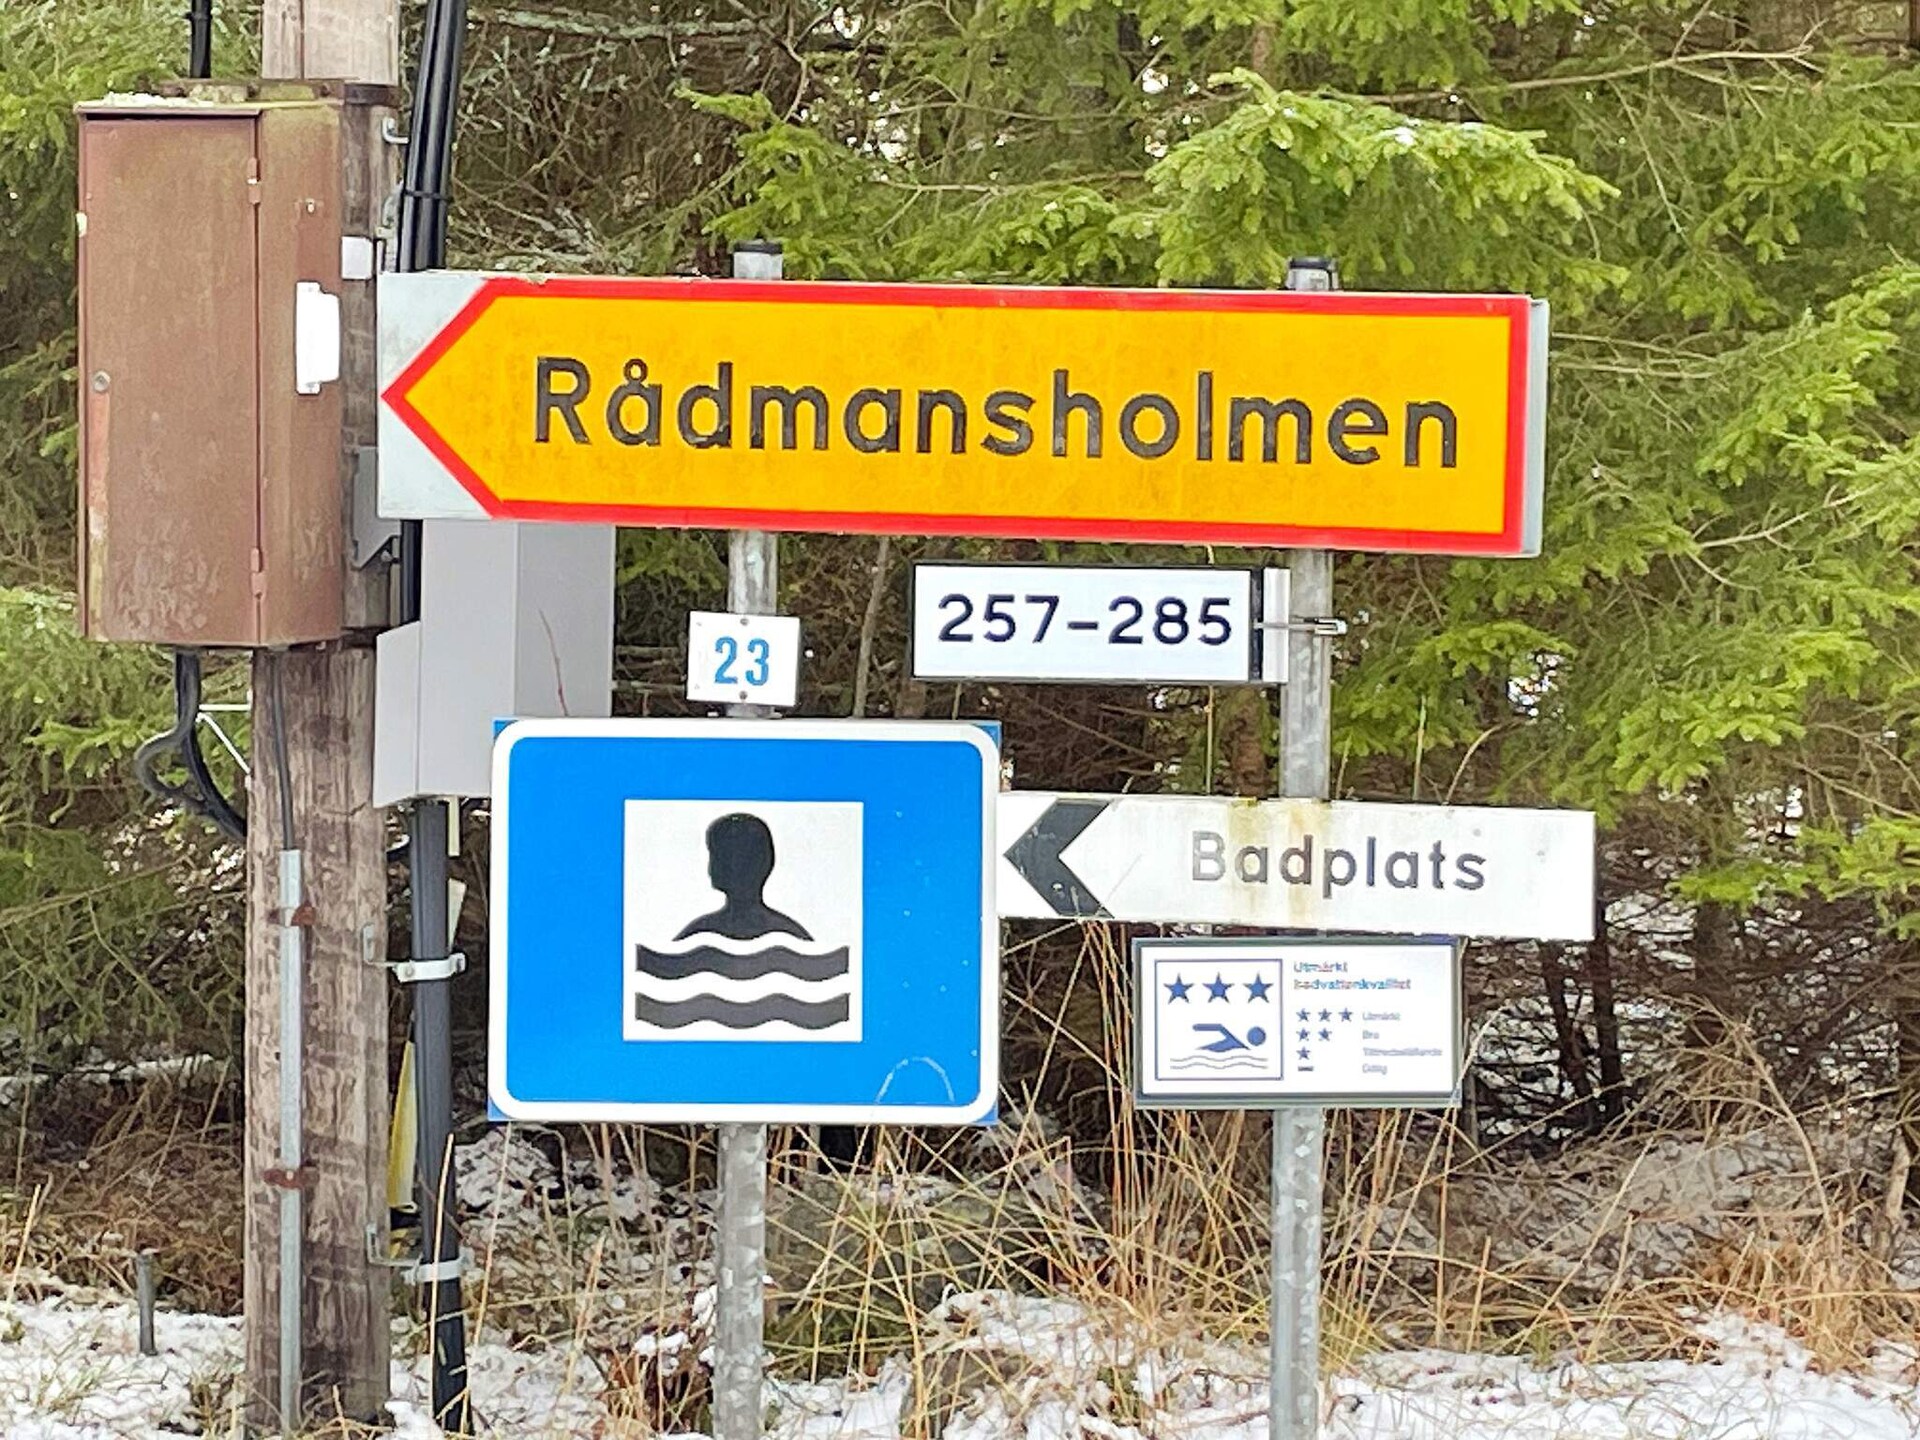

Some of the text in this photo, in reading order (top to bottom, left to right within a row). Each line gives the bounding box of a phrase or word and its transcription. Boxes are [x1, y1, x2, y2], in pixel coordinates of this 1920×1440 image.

[536, 357, 1457, 468] Rådmansholmen
[939, 594, 1232, 645] 257-285
[714, 636, 770, 686] 23
[1191, 831, 1487, 899] Badplats
